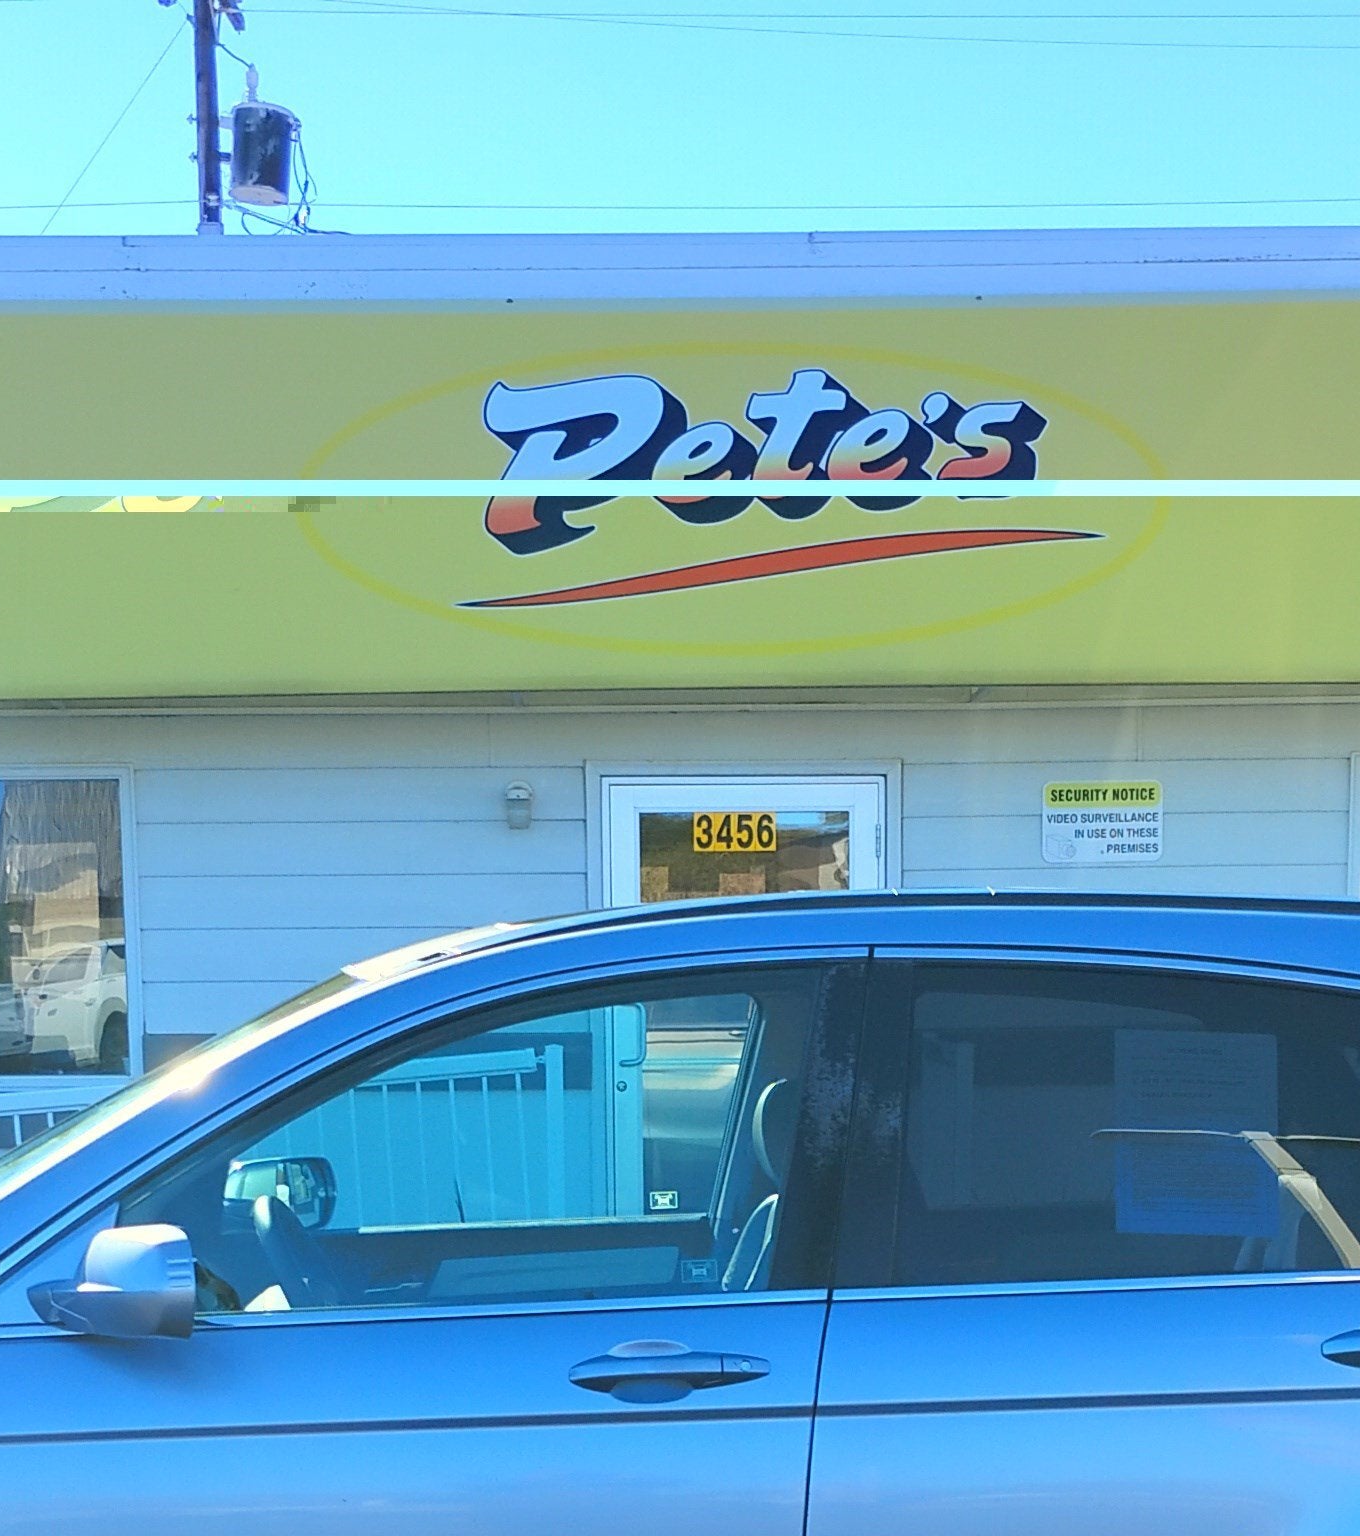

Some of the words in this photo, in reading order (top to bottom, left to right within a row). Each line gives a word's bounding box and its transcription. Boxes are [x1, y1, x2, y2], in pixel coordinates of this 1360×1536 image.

[483, 368, 1048, 555] Pete's
[1050, 788, 1108, 802] SECURITY
[1112, 787, 1155, 801] NOTICE
[1047, 814, 1078, 823] VIDEO
[1080, 812, 1159, 823] SURVEILLANCE
[695, 813, 774, 849] 3456
[1074, 829, 1084, 838] IN
[1087, 829, 1107, 838] USE
[1109, 829, 1124, 838] ON
[1126, 828, 1159, 838] THESE
[1106, 843, 1159, 854] PREMISES
